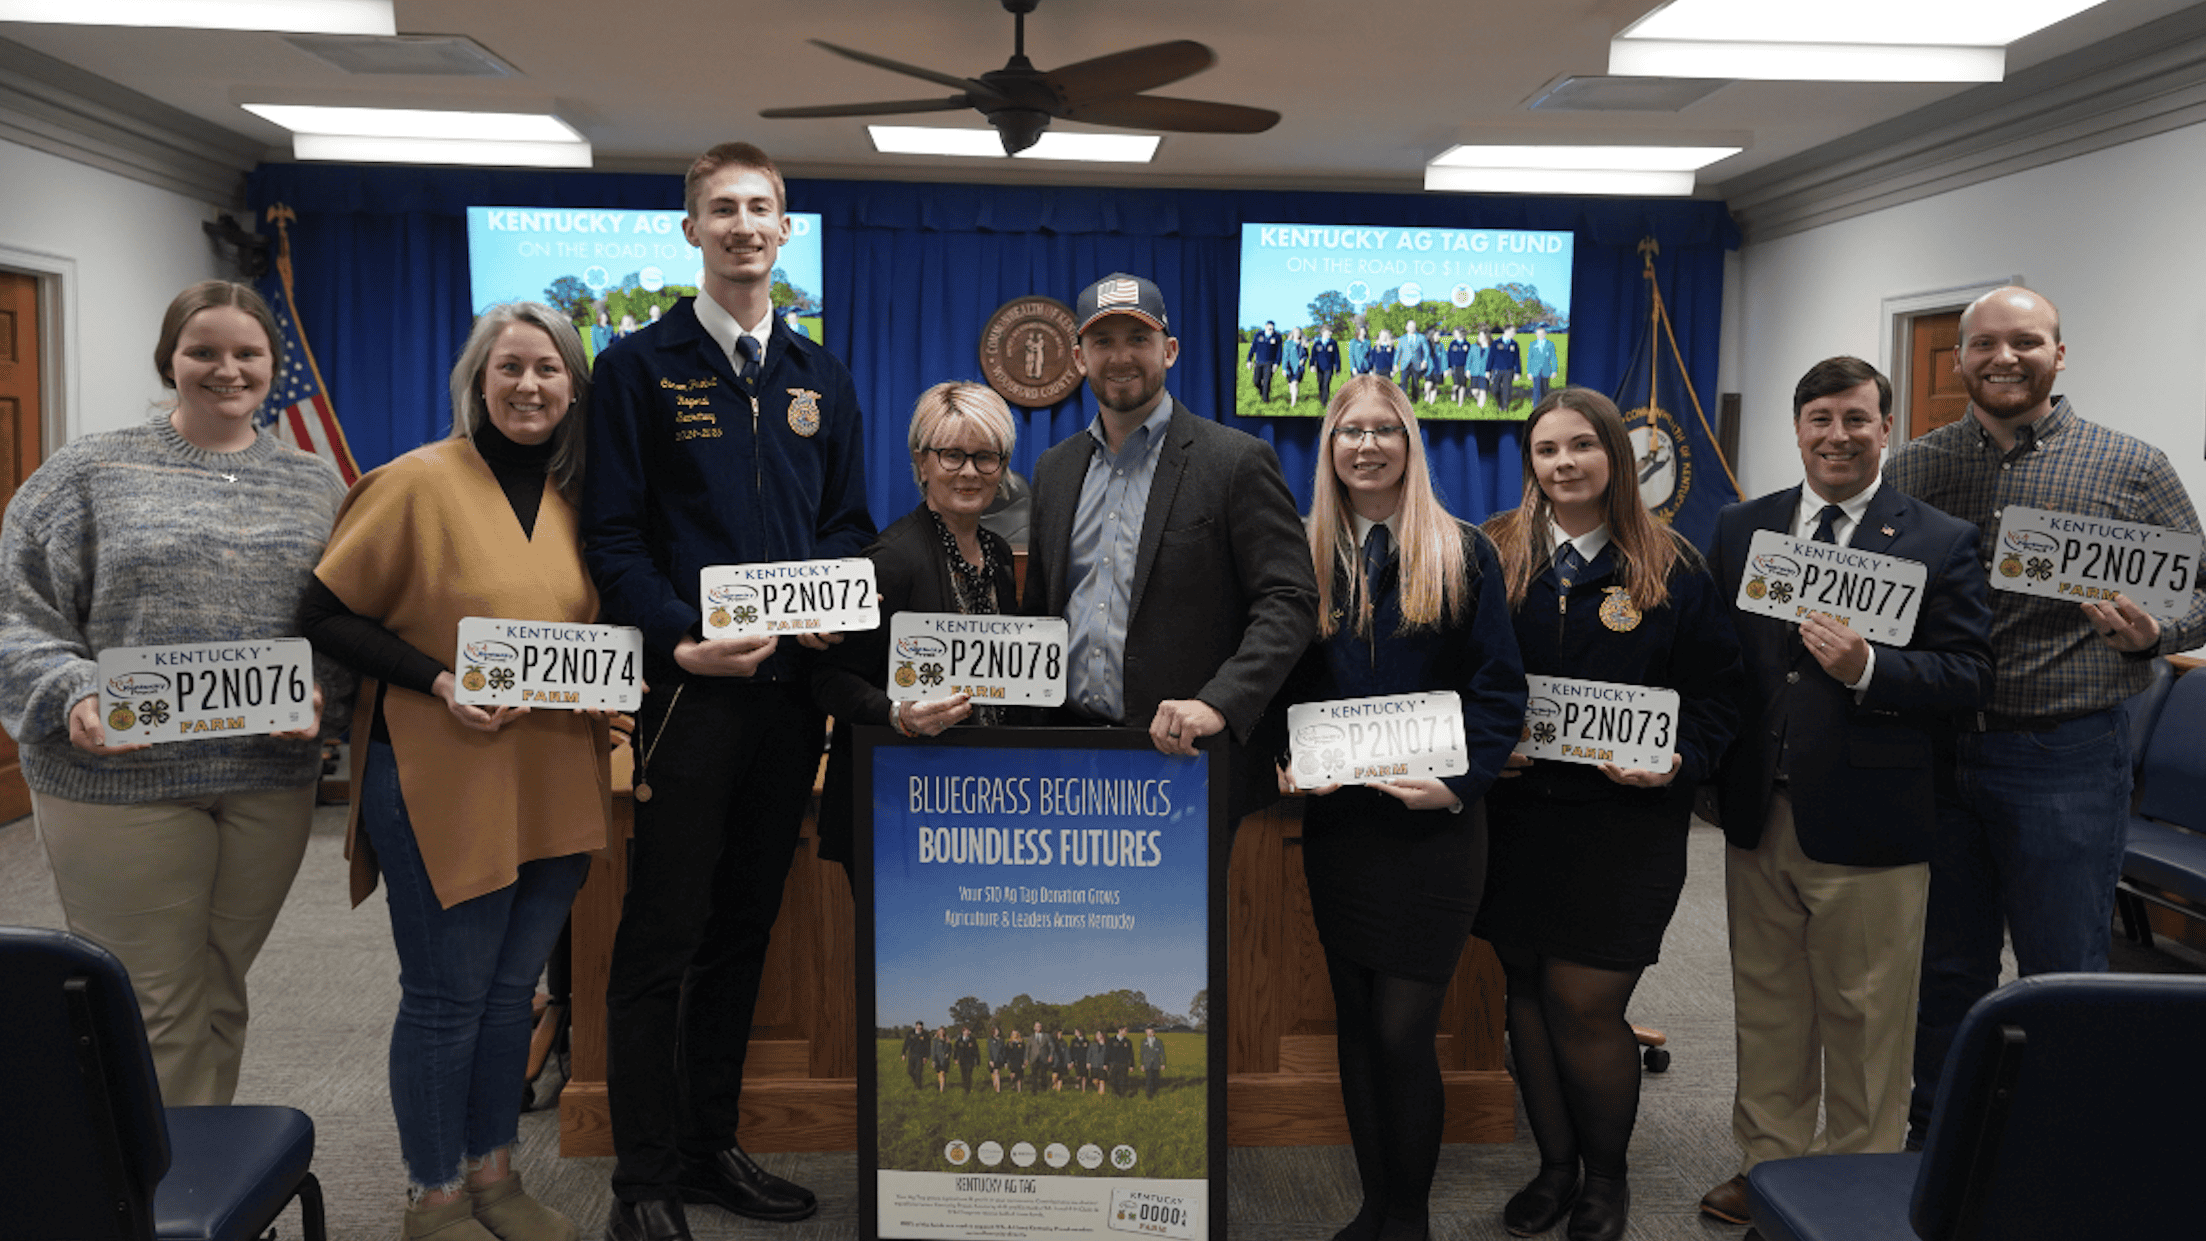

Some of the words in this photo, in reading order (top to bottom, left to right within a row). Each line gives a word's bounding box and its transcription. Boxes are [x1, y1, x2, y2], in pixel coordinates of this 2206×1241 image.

[487, 211, 626, 233] KENTUCKY
[633, 213, 672, 234] AG
[519, 240, 550, 257] ON
[555, 241, 588, 258] THE
[593, 241, 647, 259] ROAD
[653, 243, 677, 260] TO
[1260, 226, 1389, 249] KENTUCKY
[1396, 230, 1433, 251] AG
[1441, 232, 1489, 252] TAG
[1497, 234, 1562, 253] FUND
[1286, 256, 1317, 272] ON
[1322, 257, 1353, 273] THE
[1358, 258, 1407, 274] ROAD
[1413, 259, 1435, 276] TO
[1467, 262, 1535, 278] MILLION
[1040, 369, 1076, 398] COUNTY
[2050, 517, 2151, 542] KENTUCKY
[1793, 542, 1881, 572] KENTUCKY
[2060, 538, 2190, 592] P2N075
[745, 565, 831, 579] KENTUCKY
[763, 579, 872, 615] P2N072
[1799, 563, 1916, 620] P2N077
[2058, 582, 2121, 600] FARM
[507, 626, 598, 642] KENTUCKY
[766, 618, 821, 630] FARM
[936, 620, 1024, 634] KENTUCKY
[155, 647, 260, 665] KENTUCKY
[522, 645, 635, 686] P2N074
[951, 639, 1061, 680] P2N078
[176, 664, 305, 712] P2N076
[522, 689, 580, 703] FARM
[1551, 683, 1637, 702] KENTUCKY
[1331, 700, 1417, 718] KENTUCKY
[180, 716, 245, 733] FARM
[1563, 702, 1670, 748] P2N073
[1348, 715, 1458, 760] P2N071
[1561, 744, 1614, 761] FARM
[1354, 763, 1409, 779] FARM
[908, 775, 1031, 814] BLUEGRASS
[1039, 778, 1172, 817] BEGINNINGS
[918, 826, 1053, 866] BOUNDLESS
[1060, 829, 1162, 867] FUTURES
[959, 886, 983, 901] Your
[1004, 886, 1017, 904] Ag
[1019, 886, 1038, 905] Tag
[1040, 886, 1086, 904] Donation
[1088, 888, 1120, 905] Grows
[945, 909, 1000, 927] Agriculture
[1001, 911, 1010, 927] &
[1012, 911, 1051, 928] Leaders
[1053, 911, 1086, 929] Across
[1088, 912, 1135, 931] Kentucky
[955, 1177, 1002, 1193] KENTUCKY
[1004, 1178, 1017, 1194] AG
[1019, 1179, 1036, 1194] TAG
[1130, 1192, 1184, 1205] KENTUCKY
[1140, 1203, 1180, 1226] 0000
